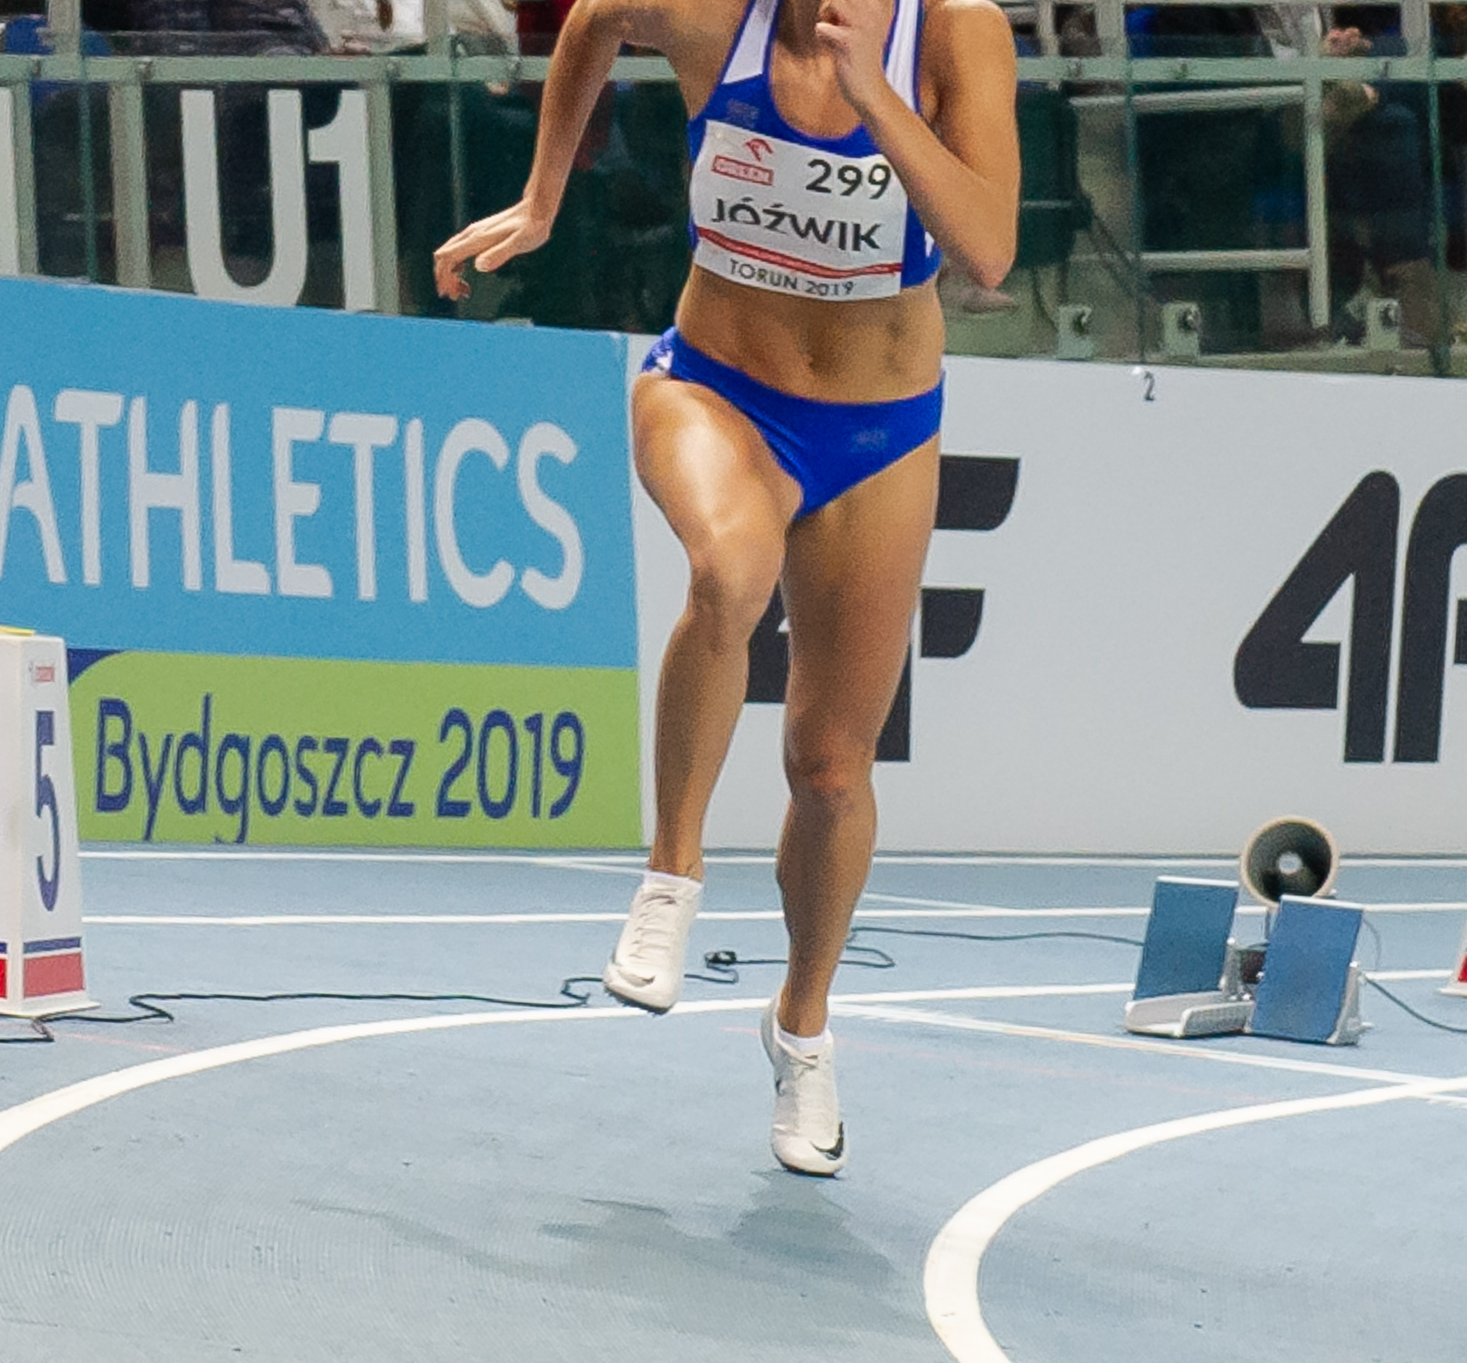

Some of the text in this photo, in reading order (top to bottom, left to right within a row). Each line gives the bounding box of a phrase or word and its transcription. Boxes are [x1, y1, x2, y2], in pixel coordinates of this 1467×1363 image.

[180, 89, 376, 312] U1
[711, 196, 882, 251] JÓŹWIK
[805, 158, 891, 200] 299
[806, 280, 855, 298] 2019
[36, 710, 61, 912] 5
[95, 692, 586, 845] Bydgoszcz 2019
